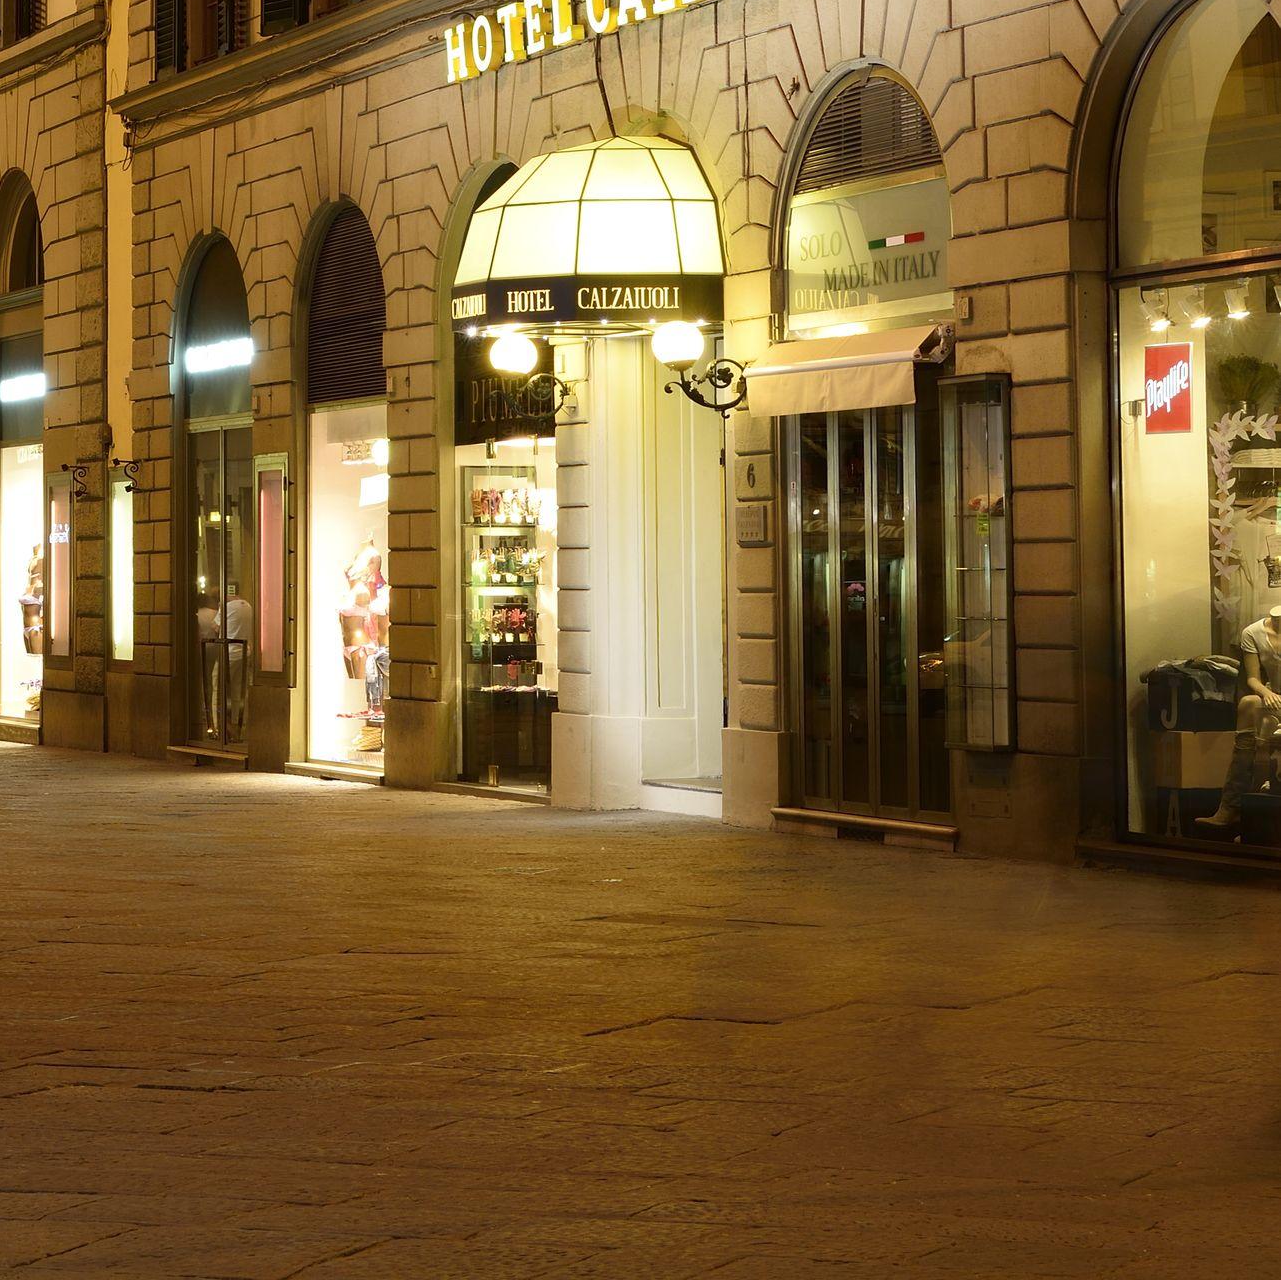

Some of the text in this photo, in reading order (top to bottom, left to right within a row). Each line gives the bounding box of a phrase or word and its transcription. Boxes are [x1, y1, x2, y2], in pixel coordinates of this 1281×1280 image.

[800, 231, 841, 262] SOLO
[823, 250, 940, 292] MADE IN ITALY
[507, 289, 555, 313] HOTEL
[577, 286, 680, 310] CALZAIUOLI
[1145, 358, 1189, 418] Playlife
[746, 462, 756, 489] 6
